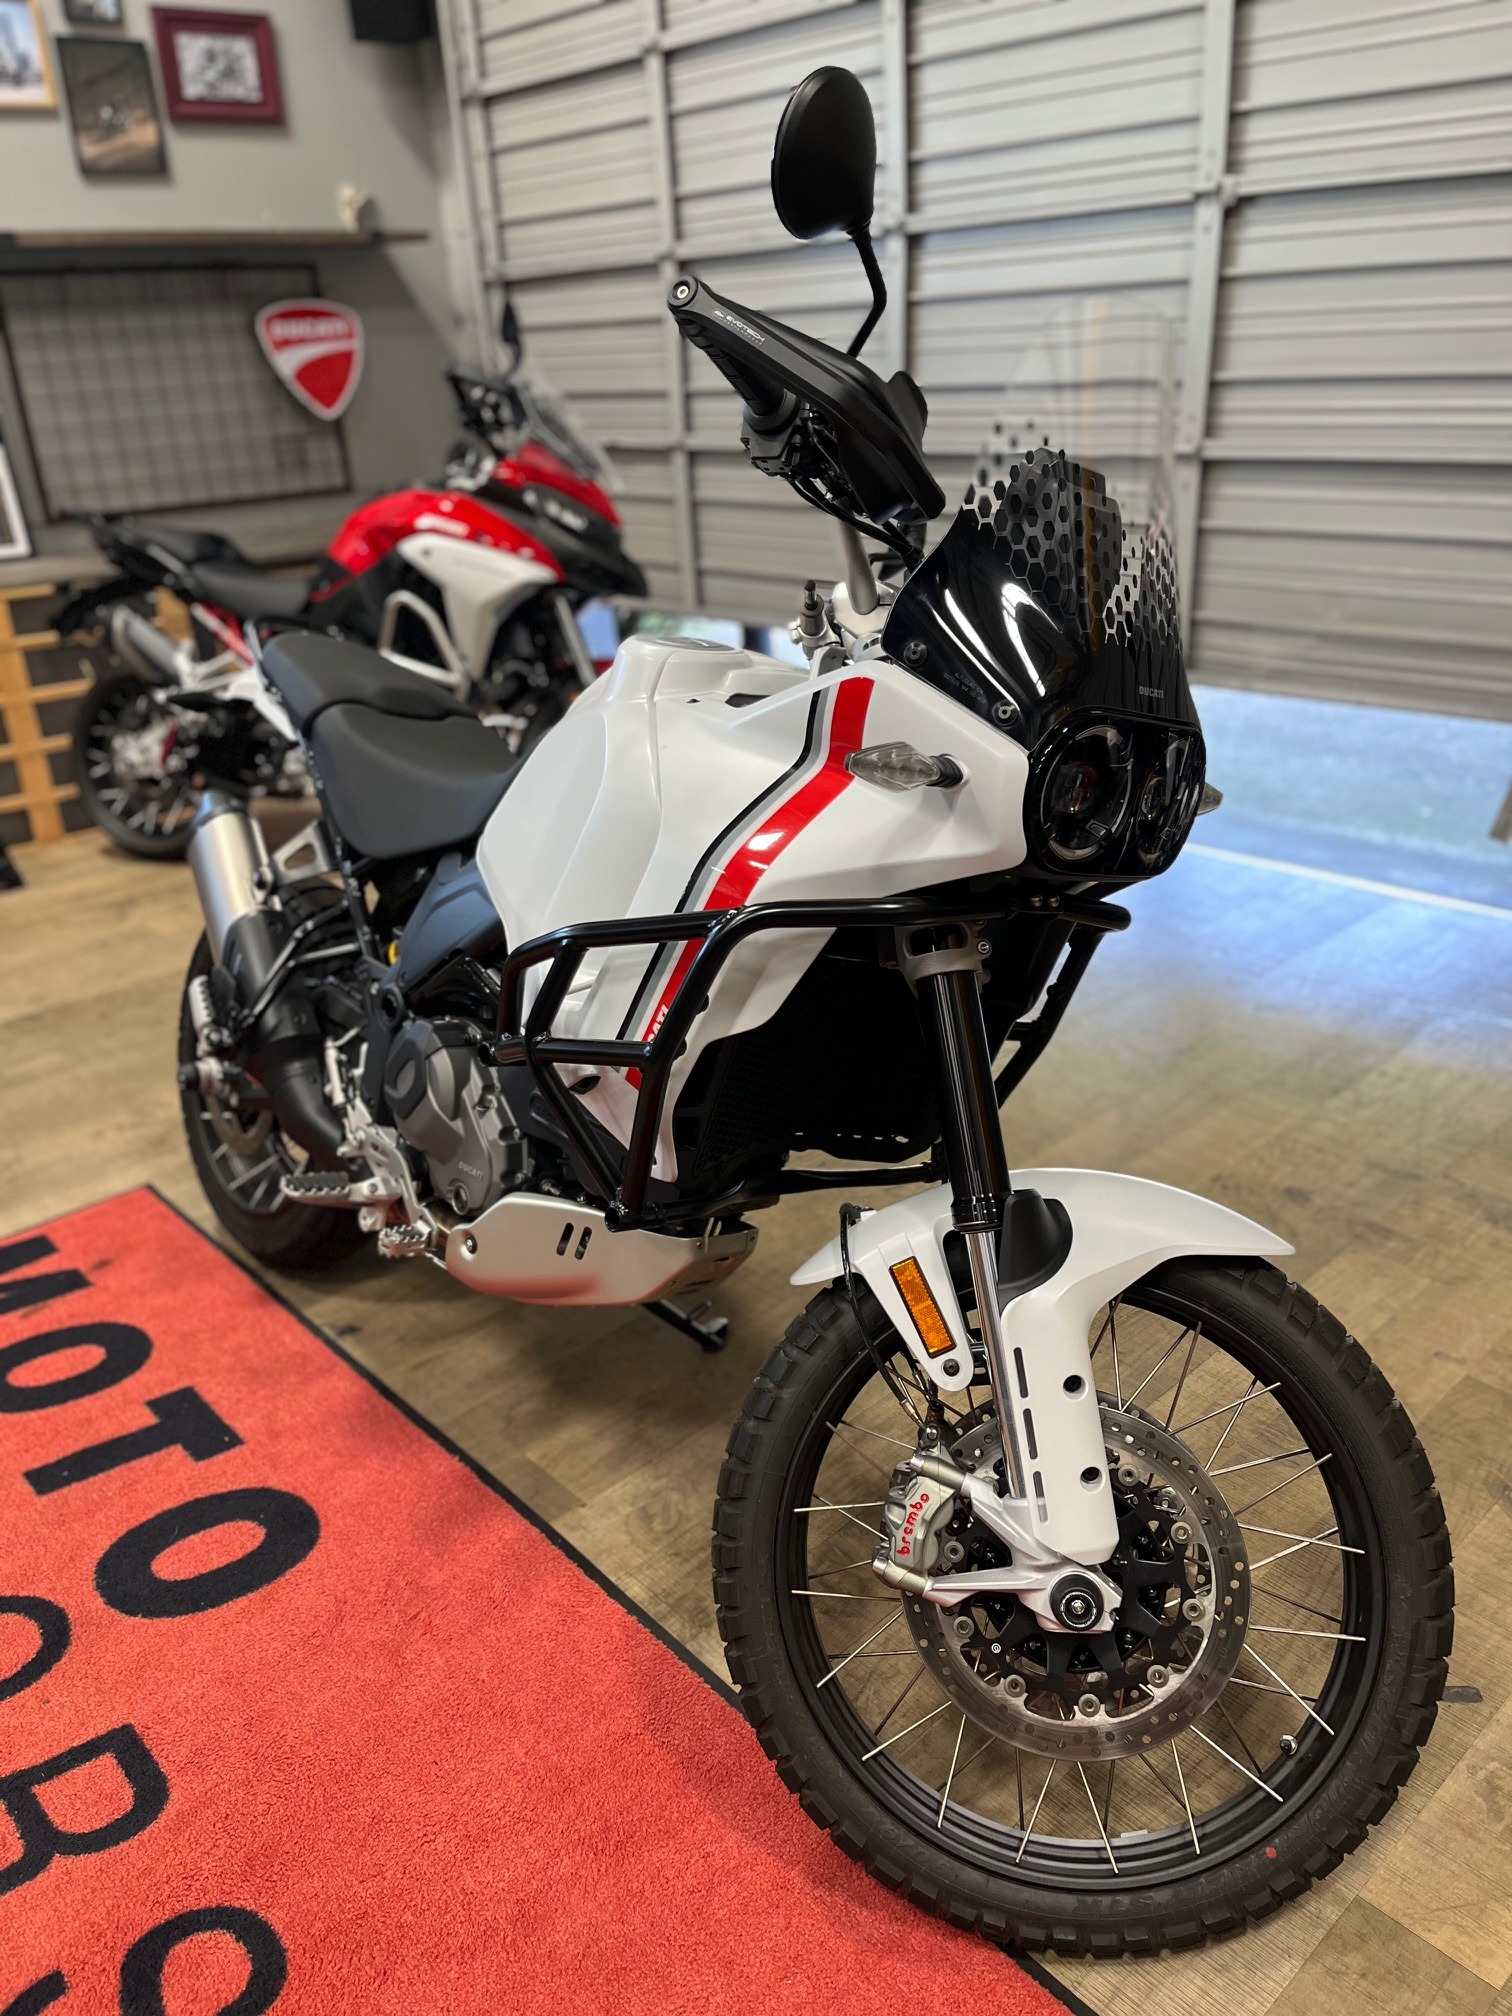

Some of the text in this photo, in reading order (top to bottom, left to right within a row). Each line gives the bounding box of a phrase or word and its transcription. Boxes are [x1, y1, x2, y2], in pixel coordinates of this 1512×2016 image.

[1139, 685, 1164, 699] DUCATI
[458, 1161, 484, 1180] DUCATI
[896, 1493, 930, 1556] brembo
